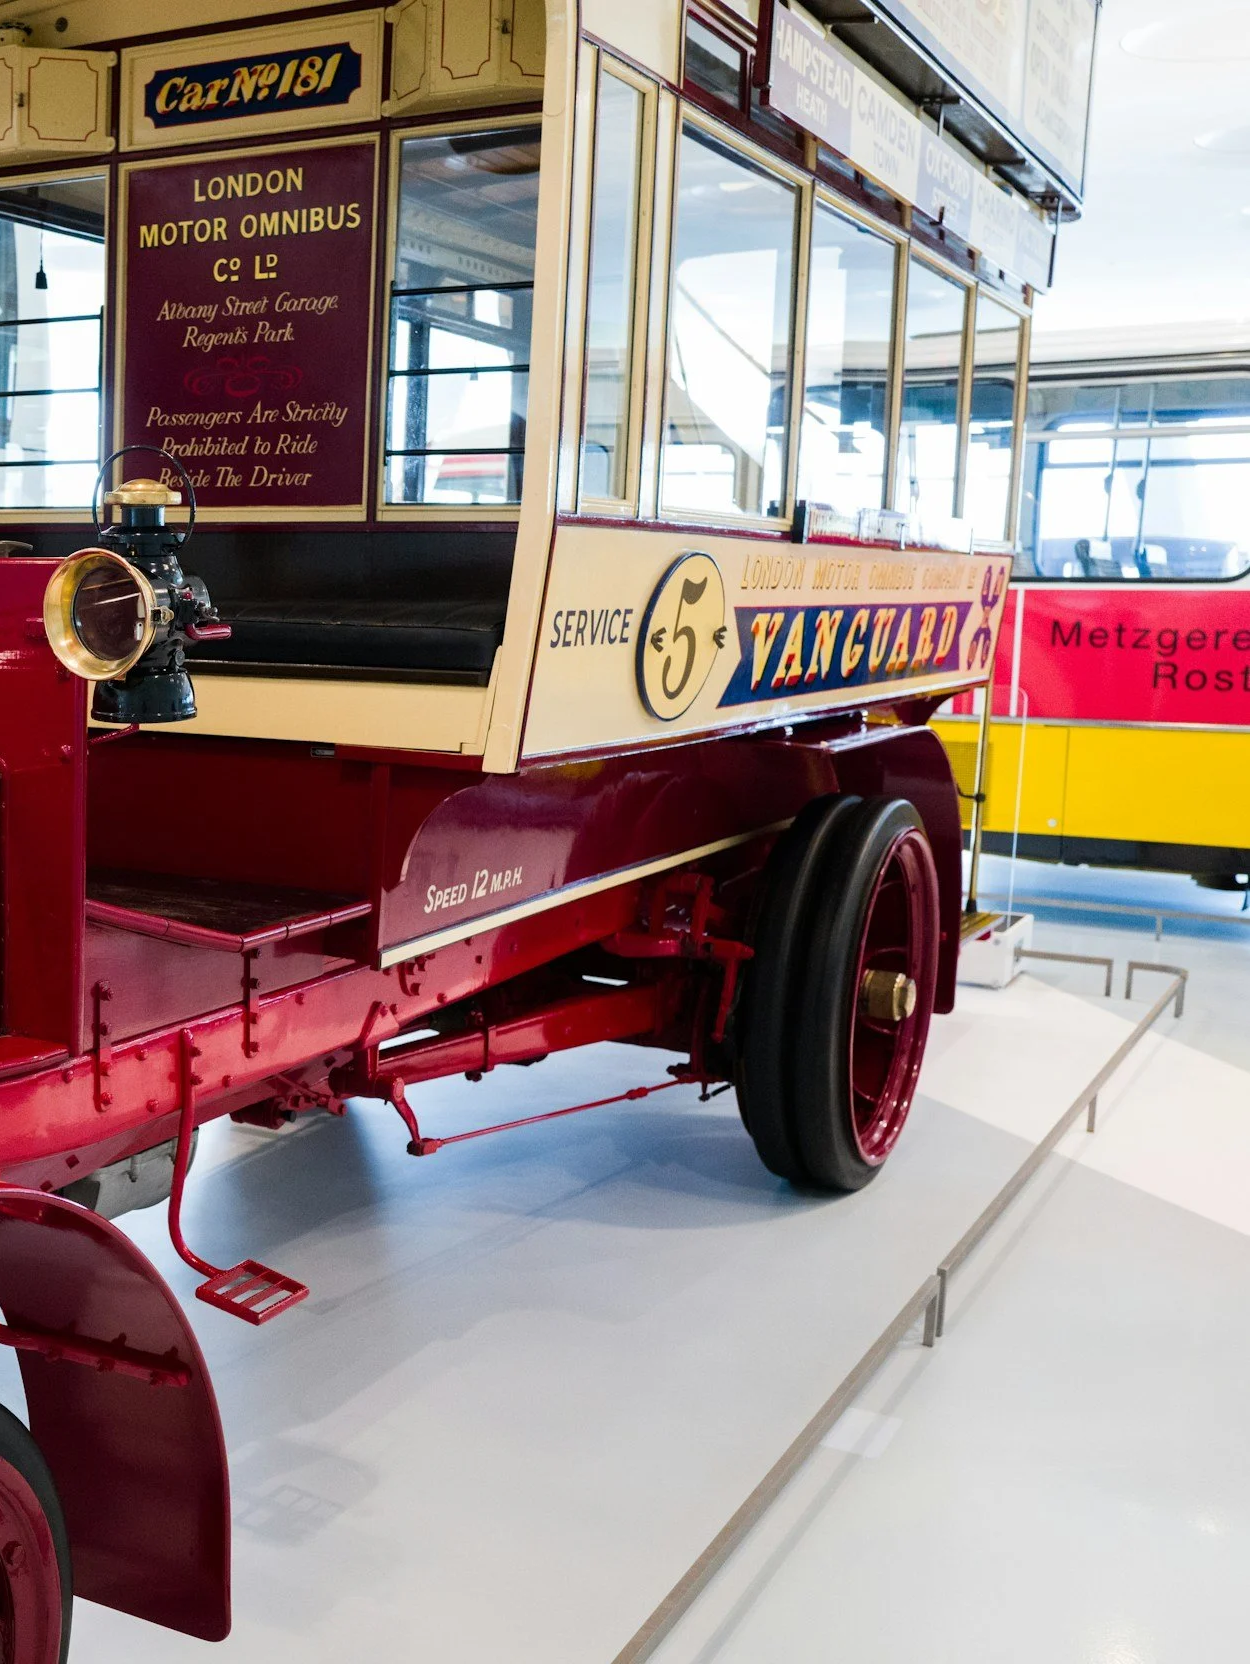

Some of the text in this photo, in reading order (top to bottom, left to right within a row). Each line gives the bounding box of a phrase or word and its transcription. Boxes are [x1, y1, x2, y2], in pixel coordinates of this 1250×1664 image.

[776, 15, 851, 109] HAMPSTEAD
[155, 76, 230, 115] Car
[276, 52, 342, 99] 181
[796, 81, 828, 127] HEATH
[857, 85, 916, 160] CAMDEN
[873, 140, 899, 180] TOWN
[926, 142, 970, 199] OXFORD
[194, 167, 303, 202] LONDON
[140, 203, 361, 248] MOTOR OMNIBUS
[157, 300, 218, 323] Albany
[222, 296, 268, 316] Street
[182, 326, 248, 352] Regent's
[146, 401, 348, 429] Passengers Are Strictly
[160, 434, 318, 457] Prohibited to Ride
[216, 467, 243, 487] The
[249, 466, 312, 487] Driver
[740, 554, 806, 590] LONDON
[811, 556, 862, 590] MOTOR
[550, 608, 633, 648] SERVICE
[662, 577, 707, 700] 5
[1051, 620, 1250, 657] Metzgere
[750, 606, 959, 692] VANGUARD
[1152, 661, 1250, 692] Rost
[471, 869, 488, 899] 12
[490, 866, 523, 894] M.P.H.
